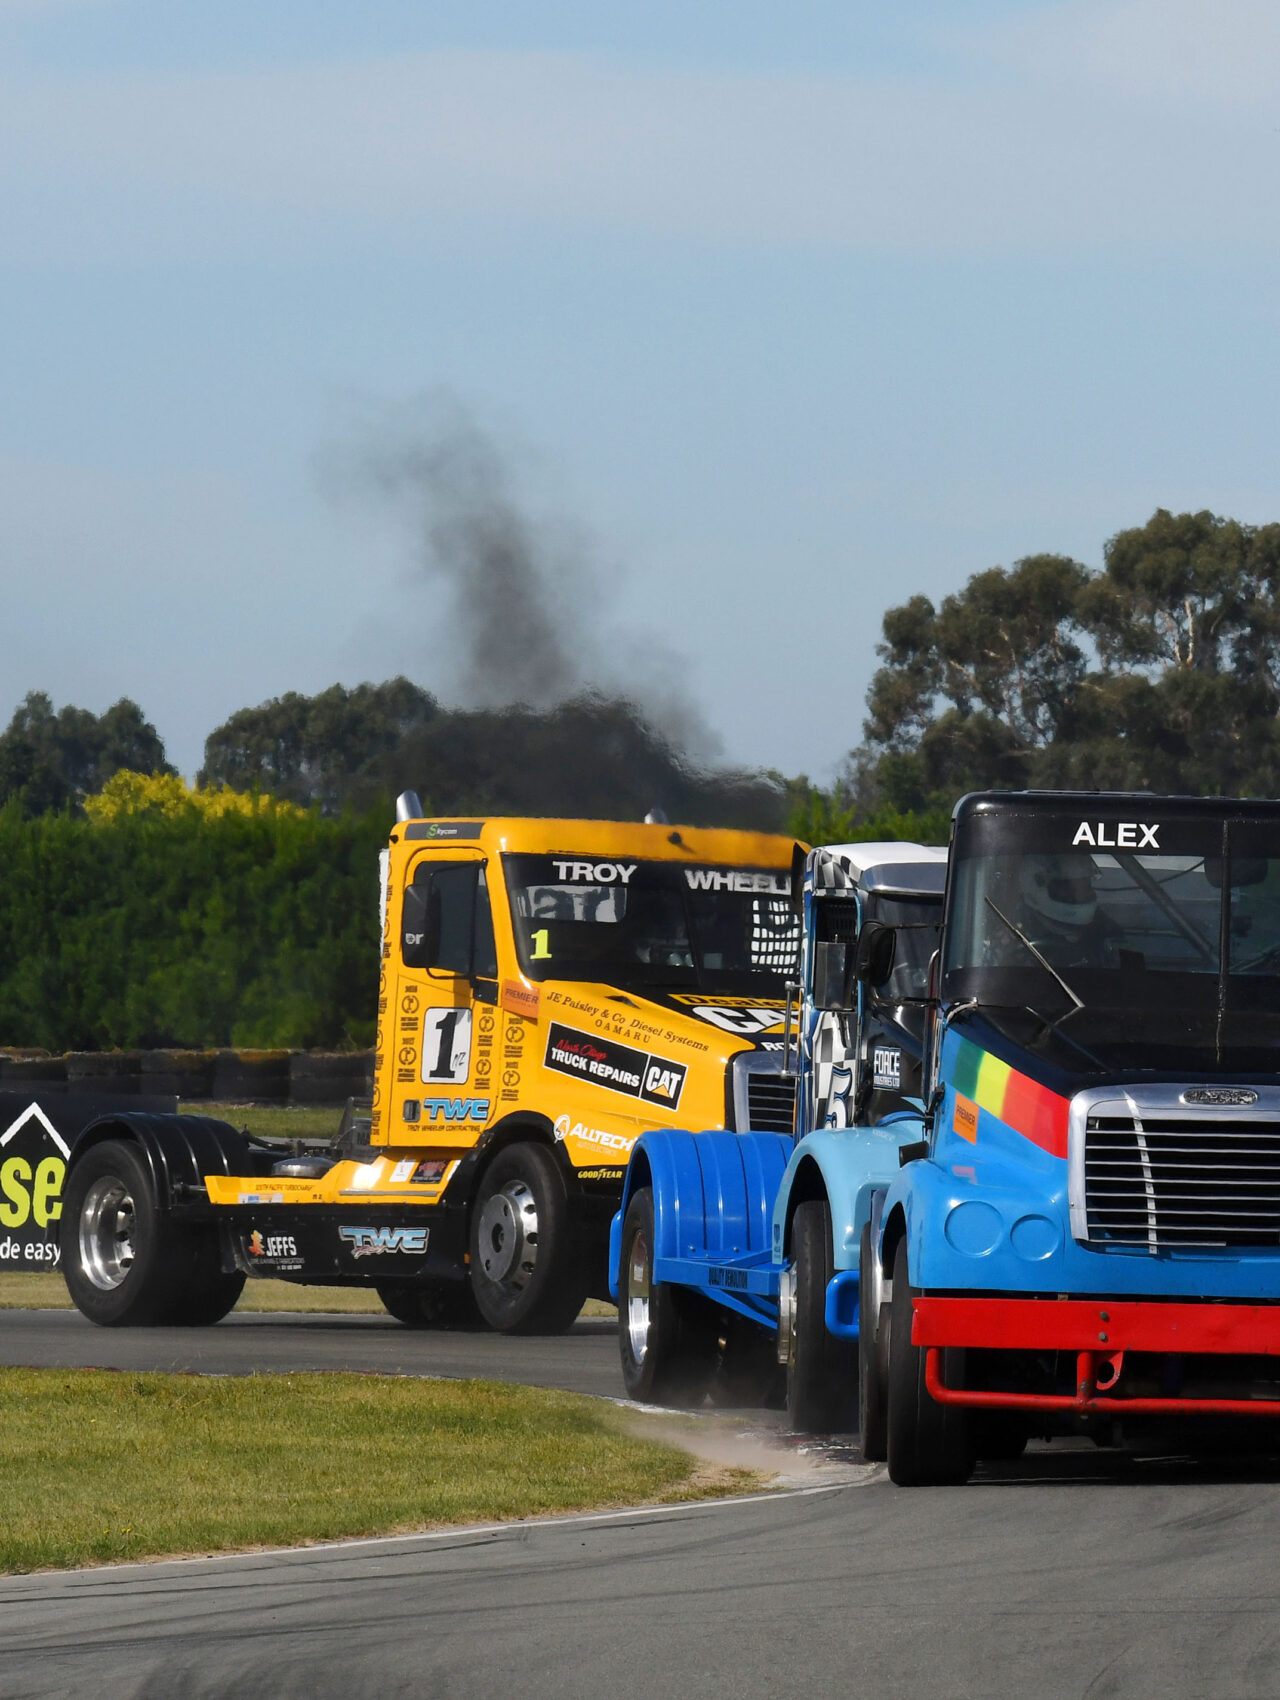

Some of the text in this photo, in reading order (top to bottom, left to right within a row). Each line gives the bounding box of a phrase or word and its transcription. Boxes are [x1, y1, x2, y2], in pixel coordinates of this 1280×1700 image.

[1072, 821, 1160, 848] ALEX
[552, 861, 792, 896] TROY WHEEL
[529, 929, 552, 960] 1
[506, 988, 538, 1004] PREMIER
[562, 996, 600, 1016] Paisley
[600, 1009, 611, 1020] &
[612, 1013, 626, 1024] Co
[629, 1018, 663, 1036] Diesel
[664, 1030, 709, 1052] Systems
[595, 1019, 651, 1044] OAMARU
[429, 1012, 458, 1079] 1
[551, 1047, 640, 1087] TRUCK REPAIRS
[873, 1050, 901, 1076] FORCE
[645, 1066, 682, 1099] CAT
[423, 1098, 491, 1122] TWC
[956, 1104, 976, 1126] PREMIER
[569, 1122, 634, 1152] ALLTECH
[577, 1168, 623, 1180] GOODYEAR
[266, 1236, 297, 1256] JEFFS
[339, 1226, 429, 1254] TWC
[24, 1243, 61, 1266] easy
